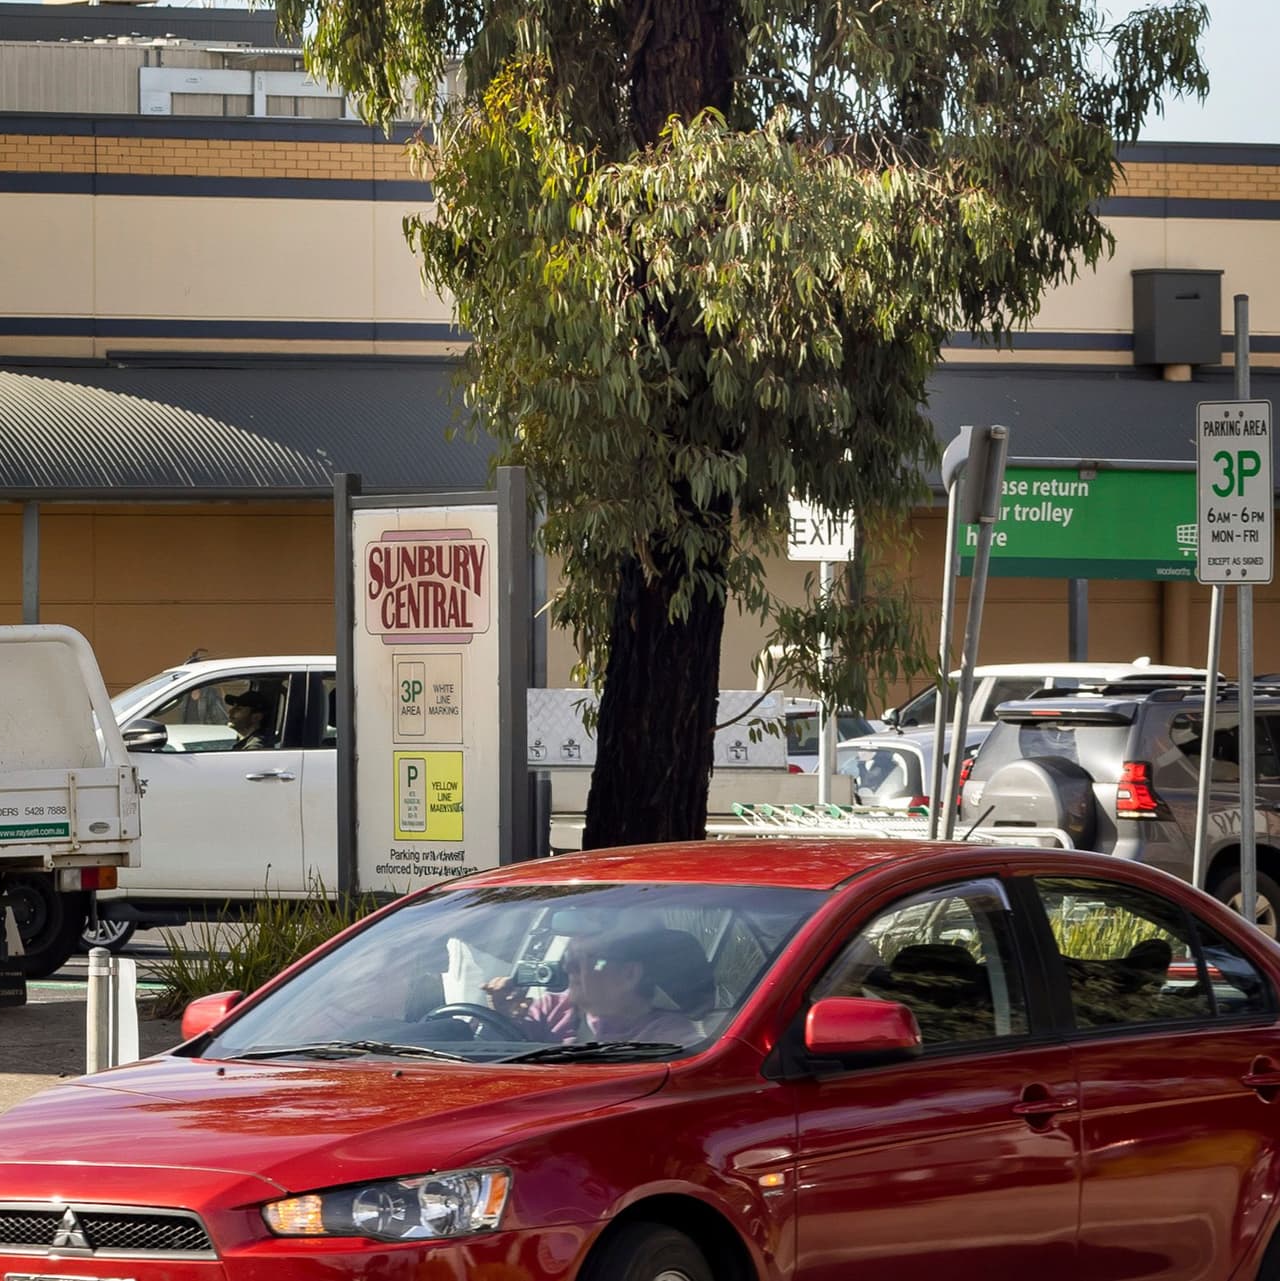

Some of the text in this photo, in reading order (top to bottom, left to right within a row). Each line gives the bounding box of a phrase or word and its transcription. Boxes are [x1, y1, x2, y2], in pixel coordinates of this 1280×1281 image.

[1203, 420, 1268, 437] PARKING AREA
[1212, 450, 1262, 498] 3P
[1001, 479, 1089, 497] ase return
[1014, 502, 1074, 527] trolley
[792, 518, 849, 546] EXIT
[966, 527, 1008, 547] hre
[1208, 557, 1264, 566] EXCEPT AS SIGNED
[368, 544, 487, 600] SUNBURY
[381, 580, 474, 630] CENTRAL
[401, 680, 423, 703] 3P
[433, 684, 454, 693] WHITE
[436, 695, 451, 705] LINE
[401, 706, 421, 716] AREA
[428, 706, 459, 715] MARKING
[407, 765, 418, 788] P
[432, 781, 458, 791] YELLOW
[437, 792, 452, 801] LINE
[24, 806, 45, 816] 5428
[390, 848, 419, 863] Parking
[376, 863, 412, 874] enforced
